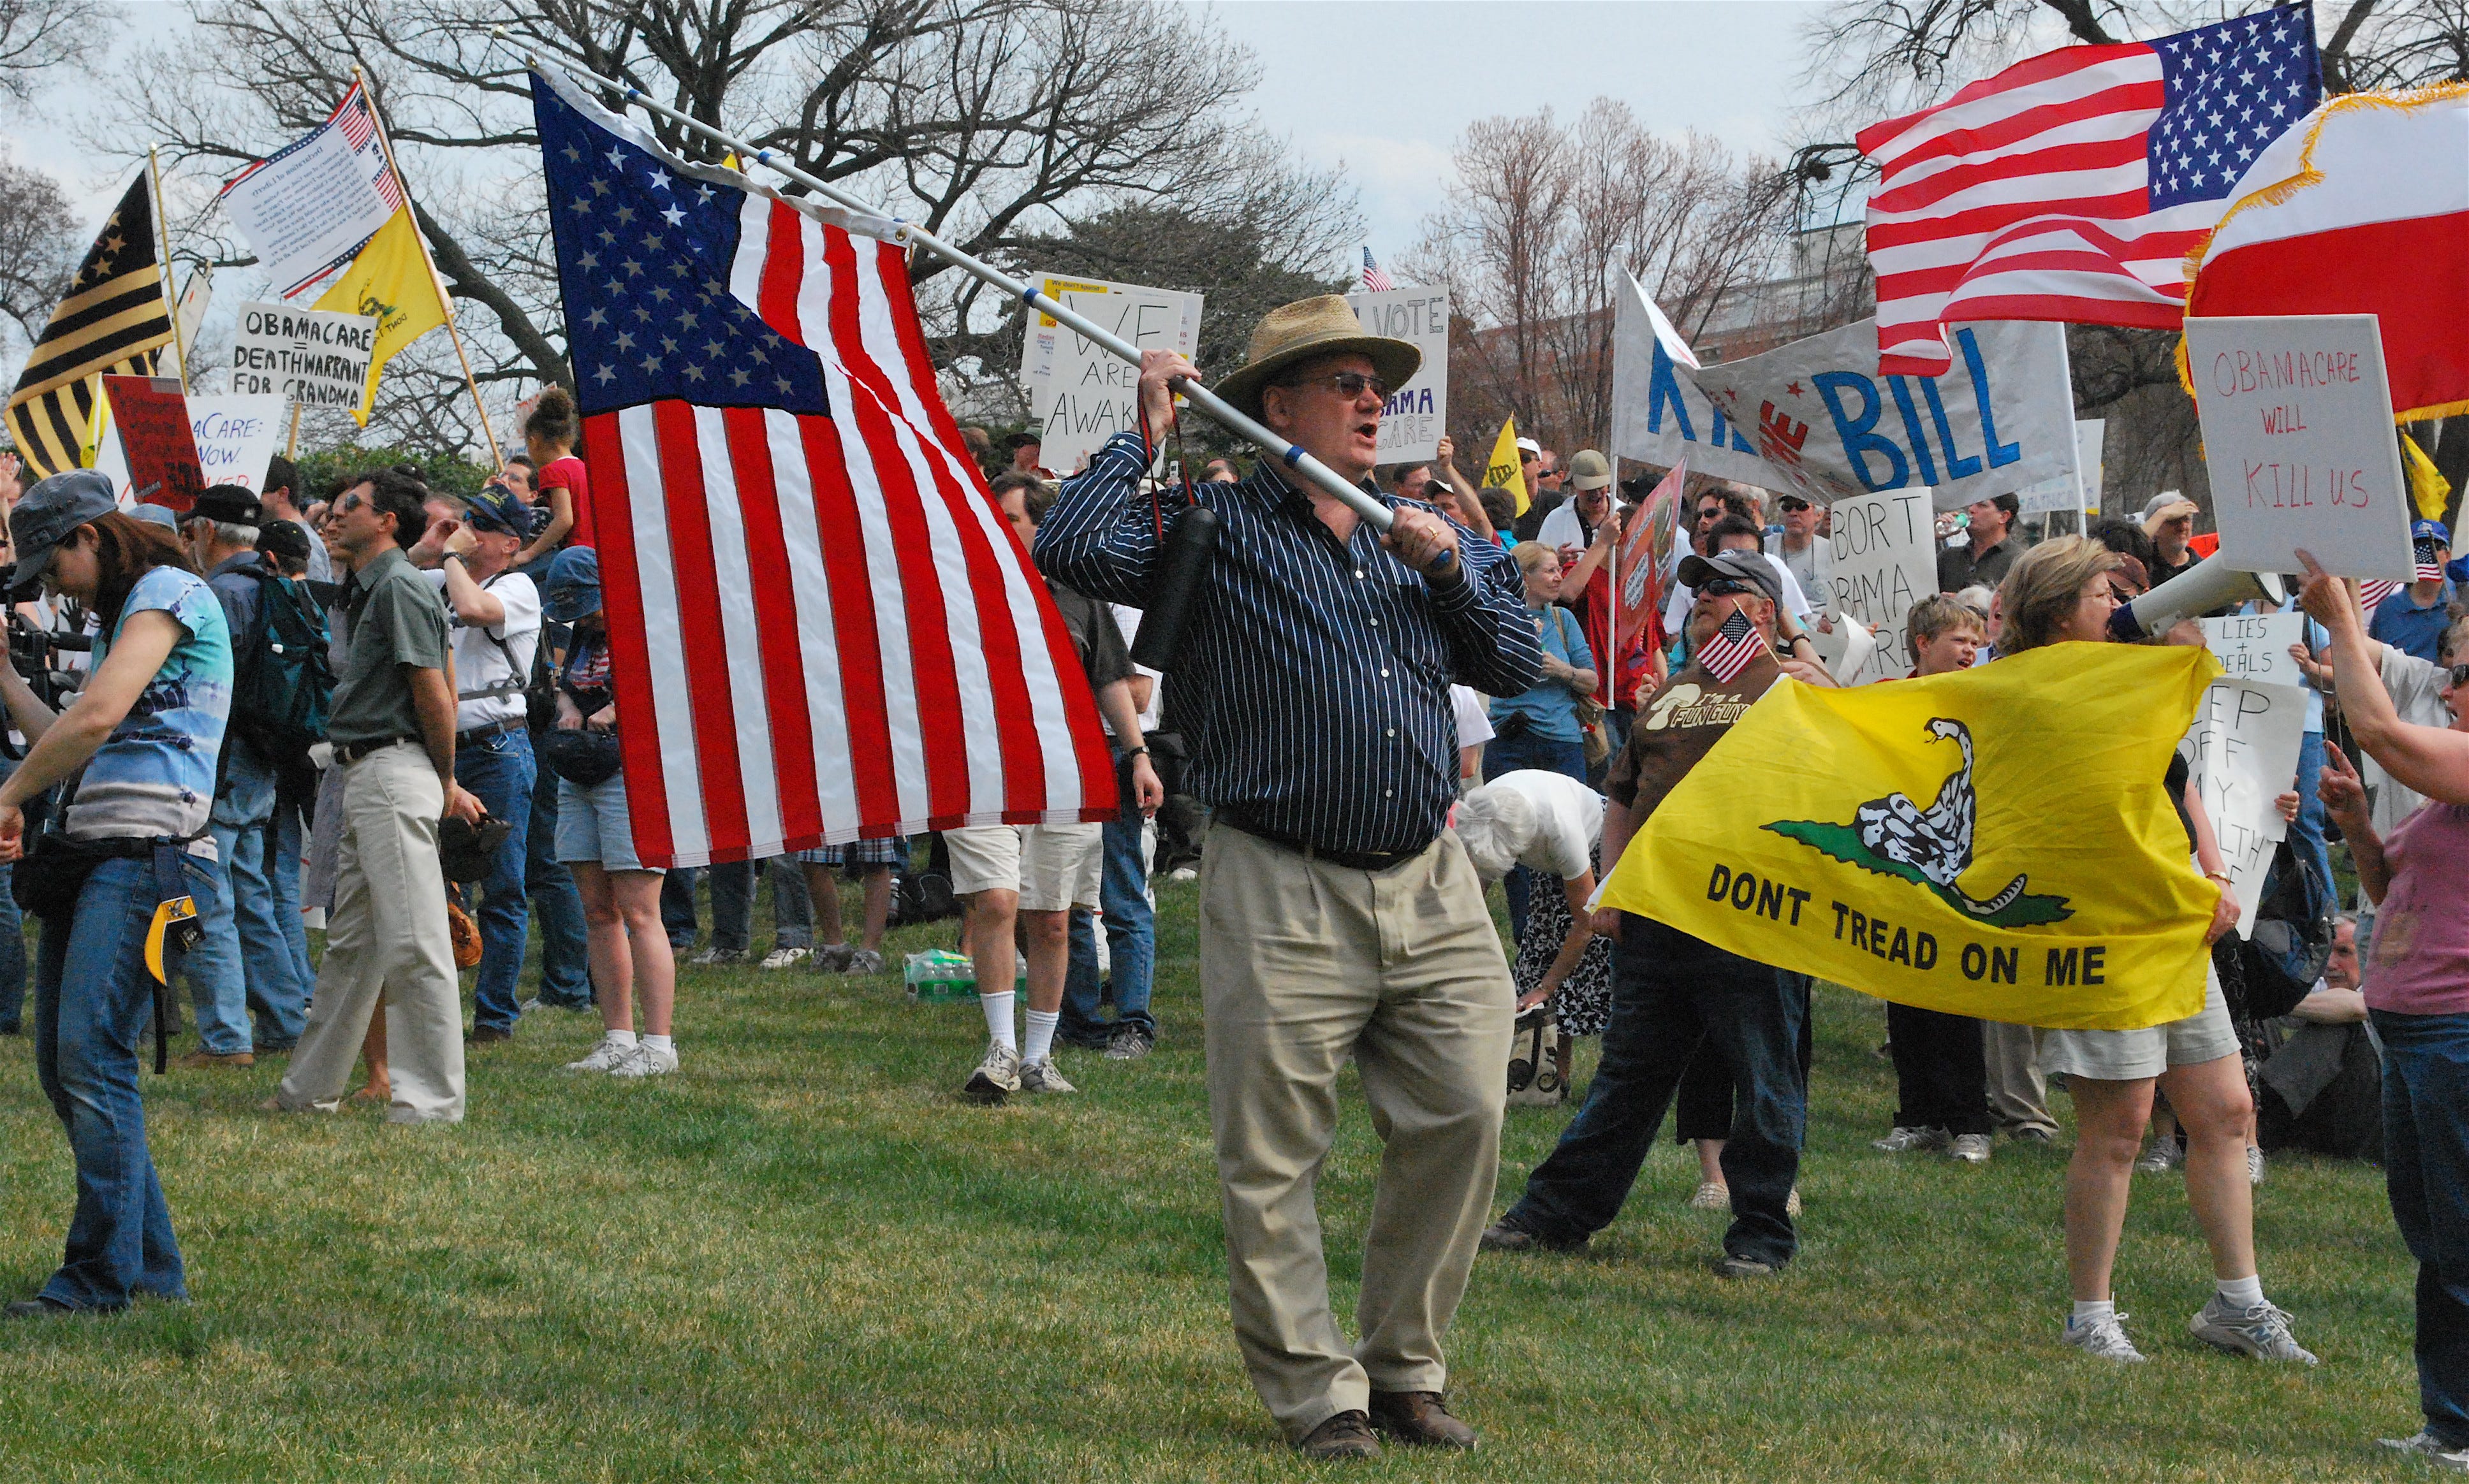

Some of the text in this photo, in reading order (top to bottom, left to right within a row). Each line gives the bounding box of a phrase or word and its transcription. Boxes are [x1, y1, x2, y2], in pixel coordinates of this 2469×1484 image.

[245, 311, 372, 352] OBAMACARE
[1373, 296, 1444, 338] VOTE
[234, 372, 358, 409] FOR GRANDMA
[1081, 361, 1135, 388] ARE
[2213, 350, 2361, 396] OBAMACARE
[1380, 388, 1433, 418] AMA
[1812, 328, 2021, 493] BILL
[2261, 404, 2307, 435] WILL
[2243, 459, 2313, 508] KILL
[1830, 496, 1921, 564] BORT
[2223, 617, 2268, 639] LIES
[1707, 864, 2106, 987] DONT TREAD ON ME
